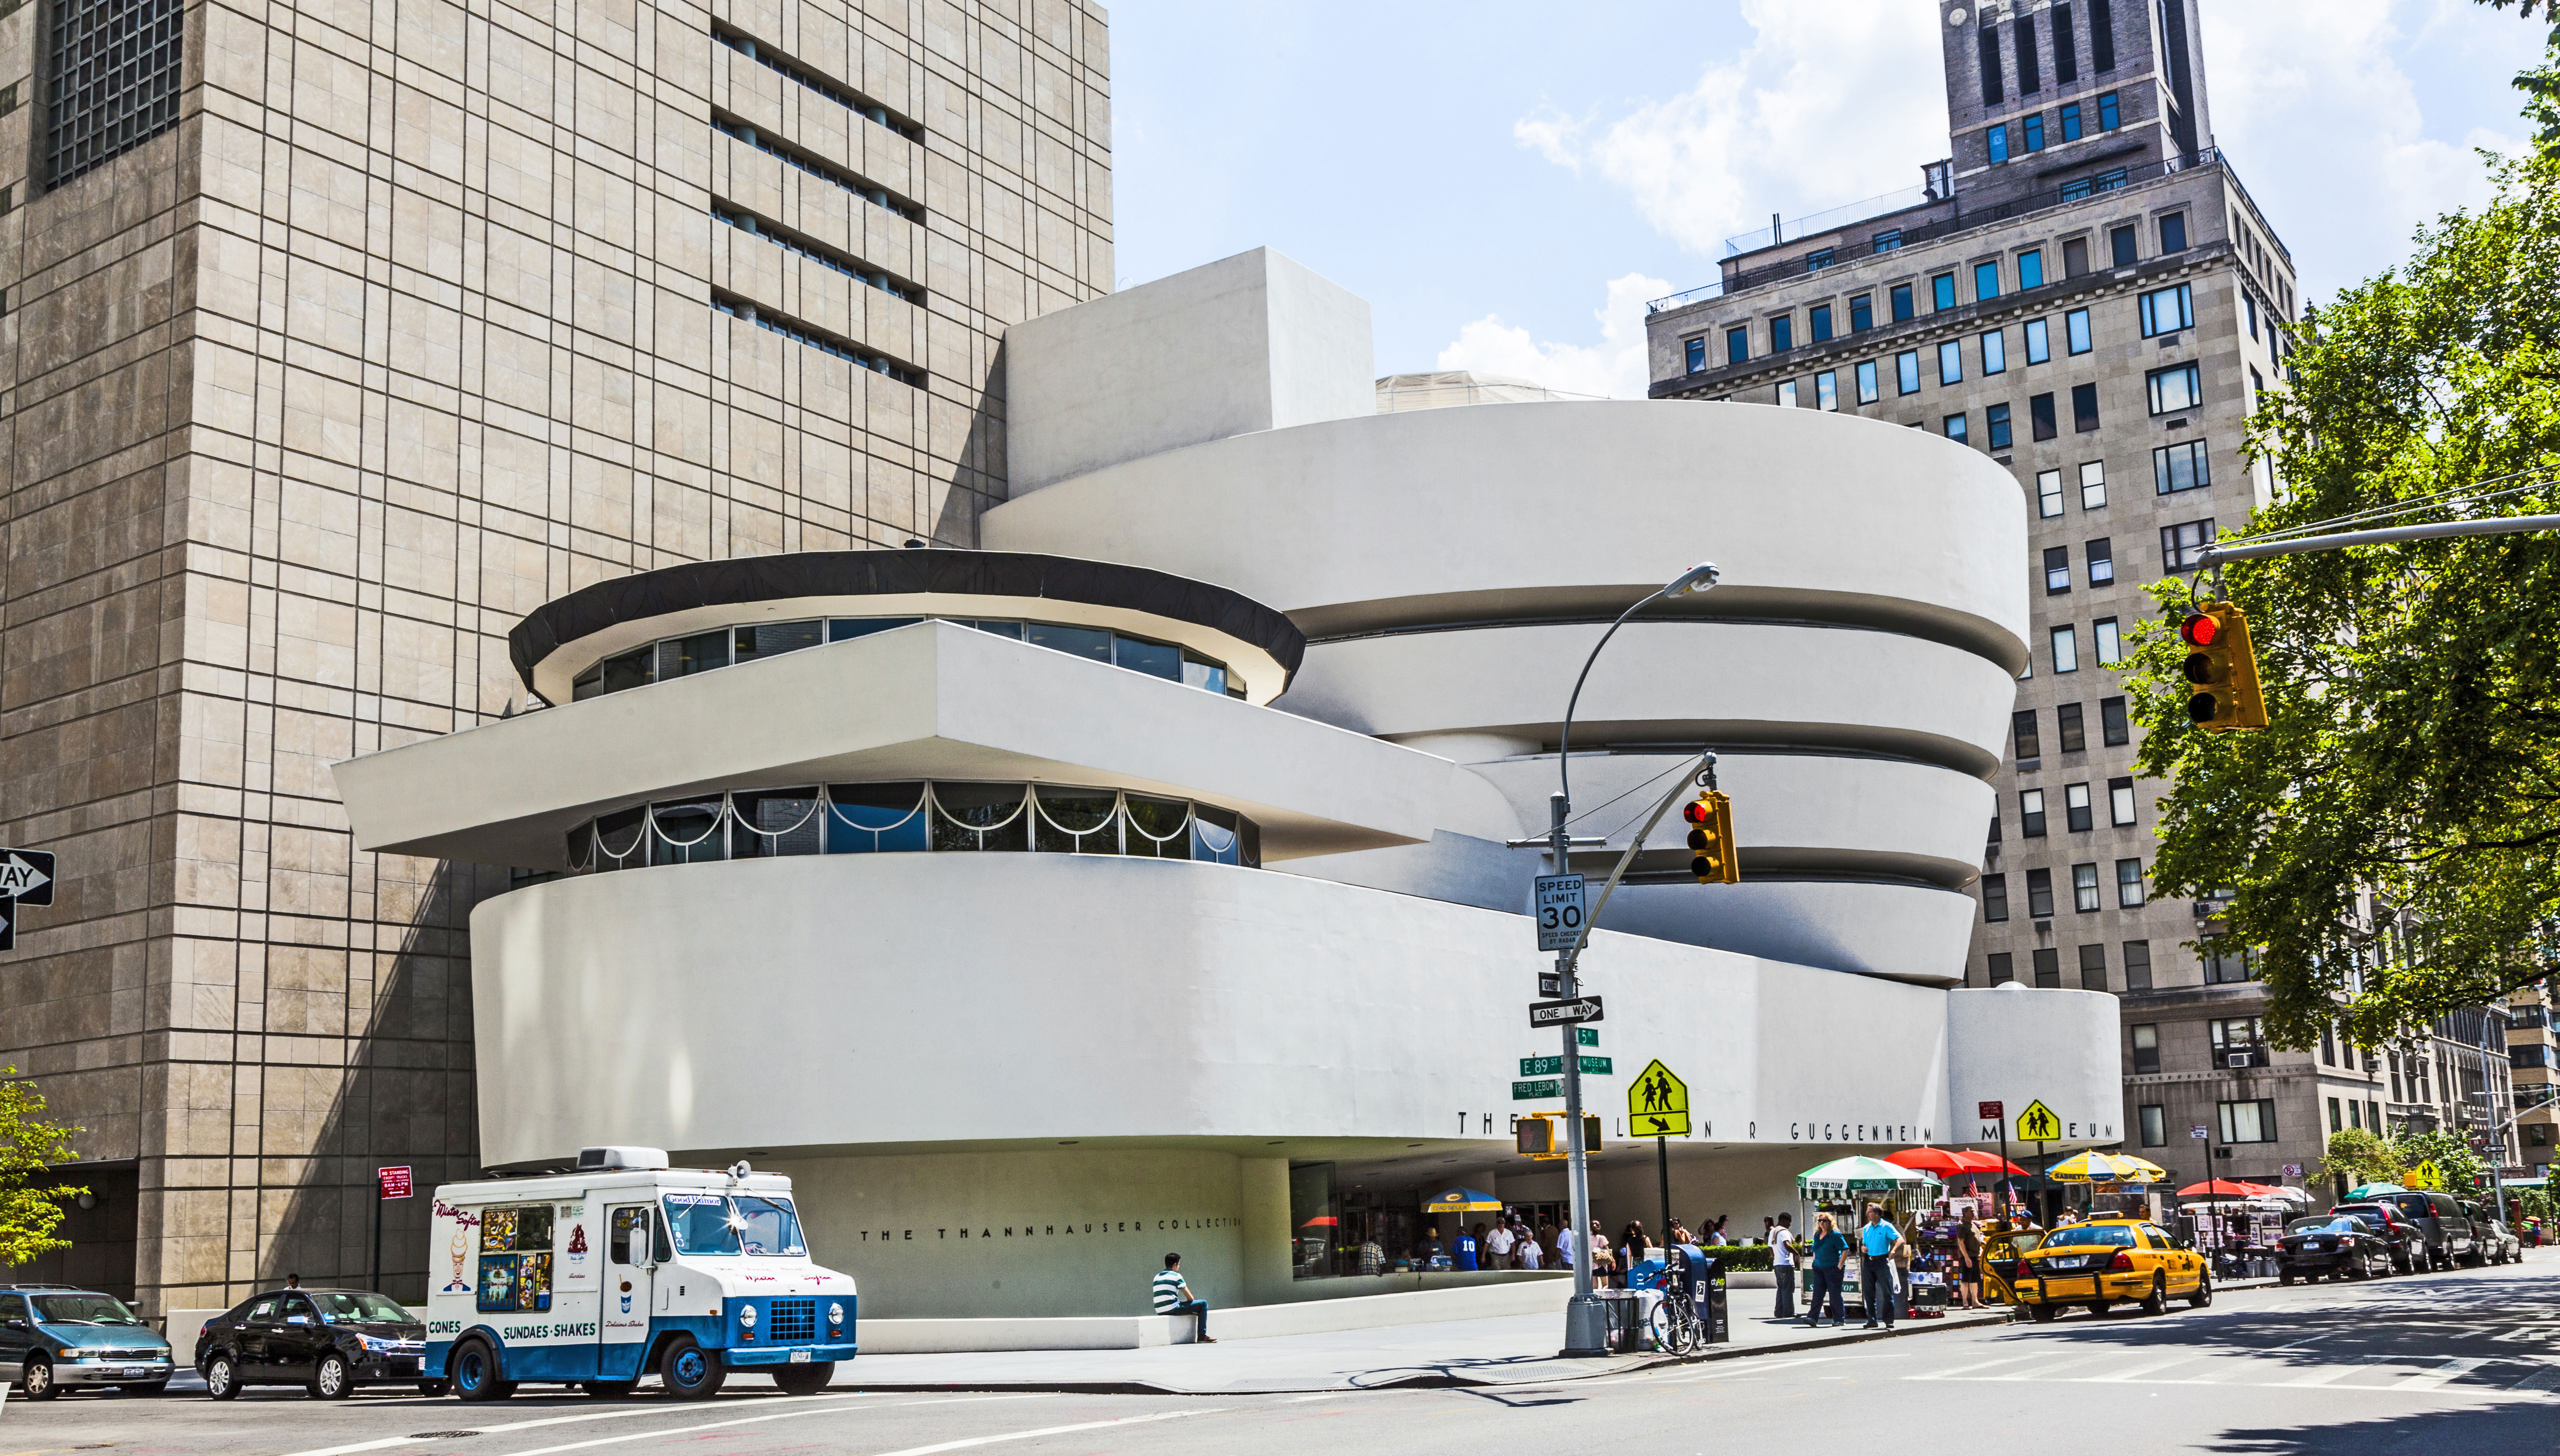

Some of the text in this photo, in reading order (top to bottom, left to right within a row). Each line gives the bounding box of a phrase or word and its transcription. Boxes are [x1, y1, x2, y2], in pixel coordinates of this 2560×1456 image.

[0, 866, 34, 887] AY
[1539, 880, 1581, 892] SPEED
[1543, 893, 1577, 904] LIMIT
[1542, 905, 1581, 929] 30
[1544, 980, 1556, 990] ONE
[1540, 1004, 1593, 1019] ONE WAY
[1582, 1029, 1586, 1043] 5
[1524, 1061, 1530, 1074] E
[1535, 1059, 1547, 1073] 89
[1583, 1058, 1607, 1067] MUSEUM
[1514, 1081, 1554, 1092] FRED LEBOW
[1459, 1111, 2117, 1141] THE R GUGGENHEIM MEUM
[668, 1195, 691, 1203] Good
[434, 1199, 459, 1218] Mister
[456, 1211, 480, 1231] Softee
[861, 1230, 912, 1241] THE
[938, 1221, 1141, 1239] THANNHAUSER
[1463, 1240, 1475, 1252] 10
[429, 1321, 461, 1334] CONES
[554, 1322, 596, 1337] SHAKES
